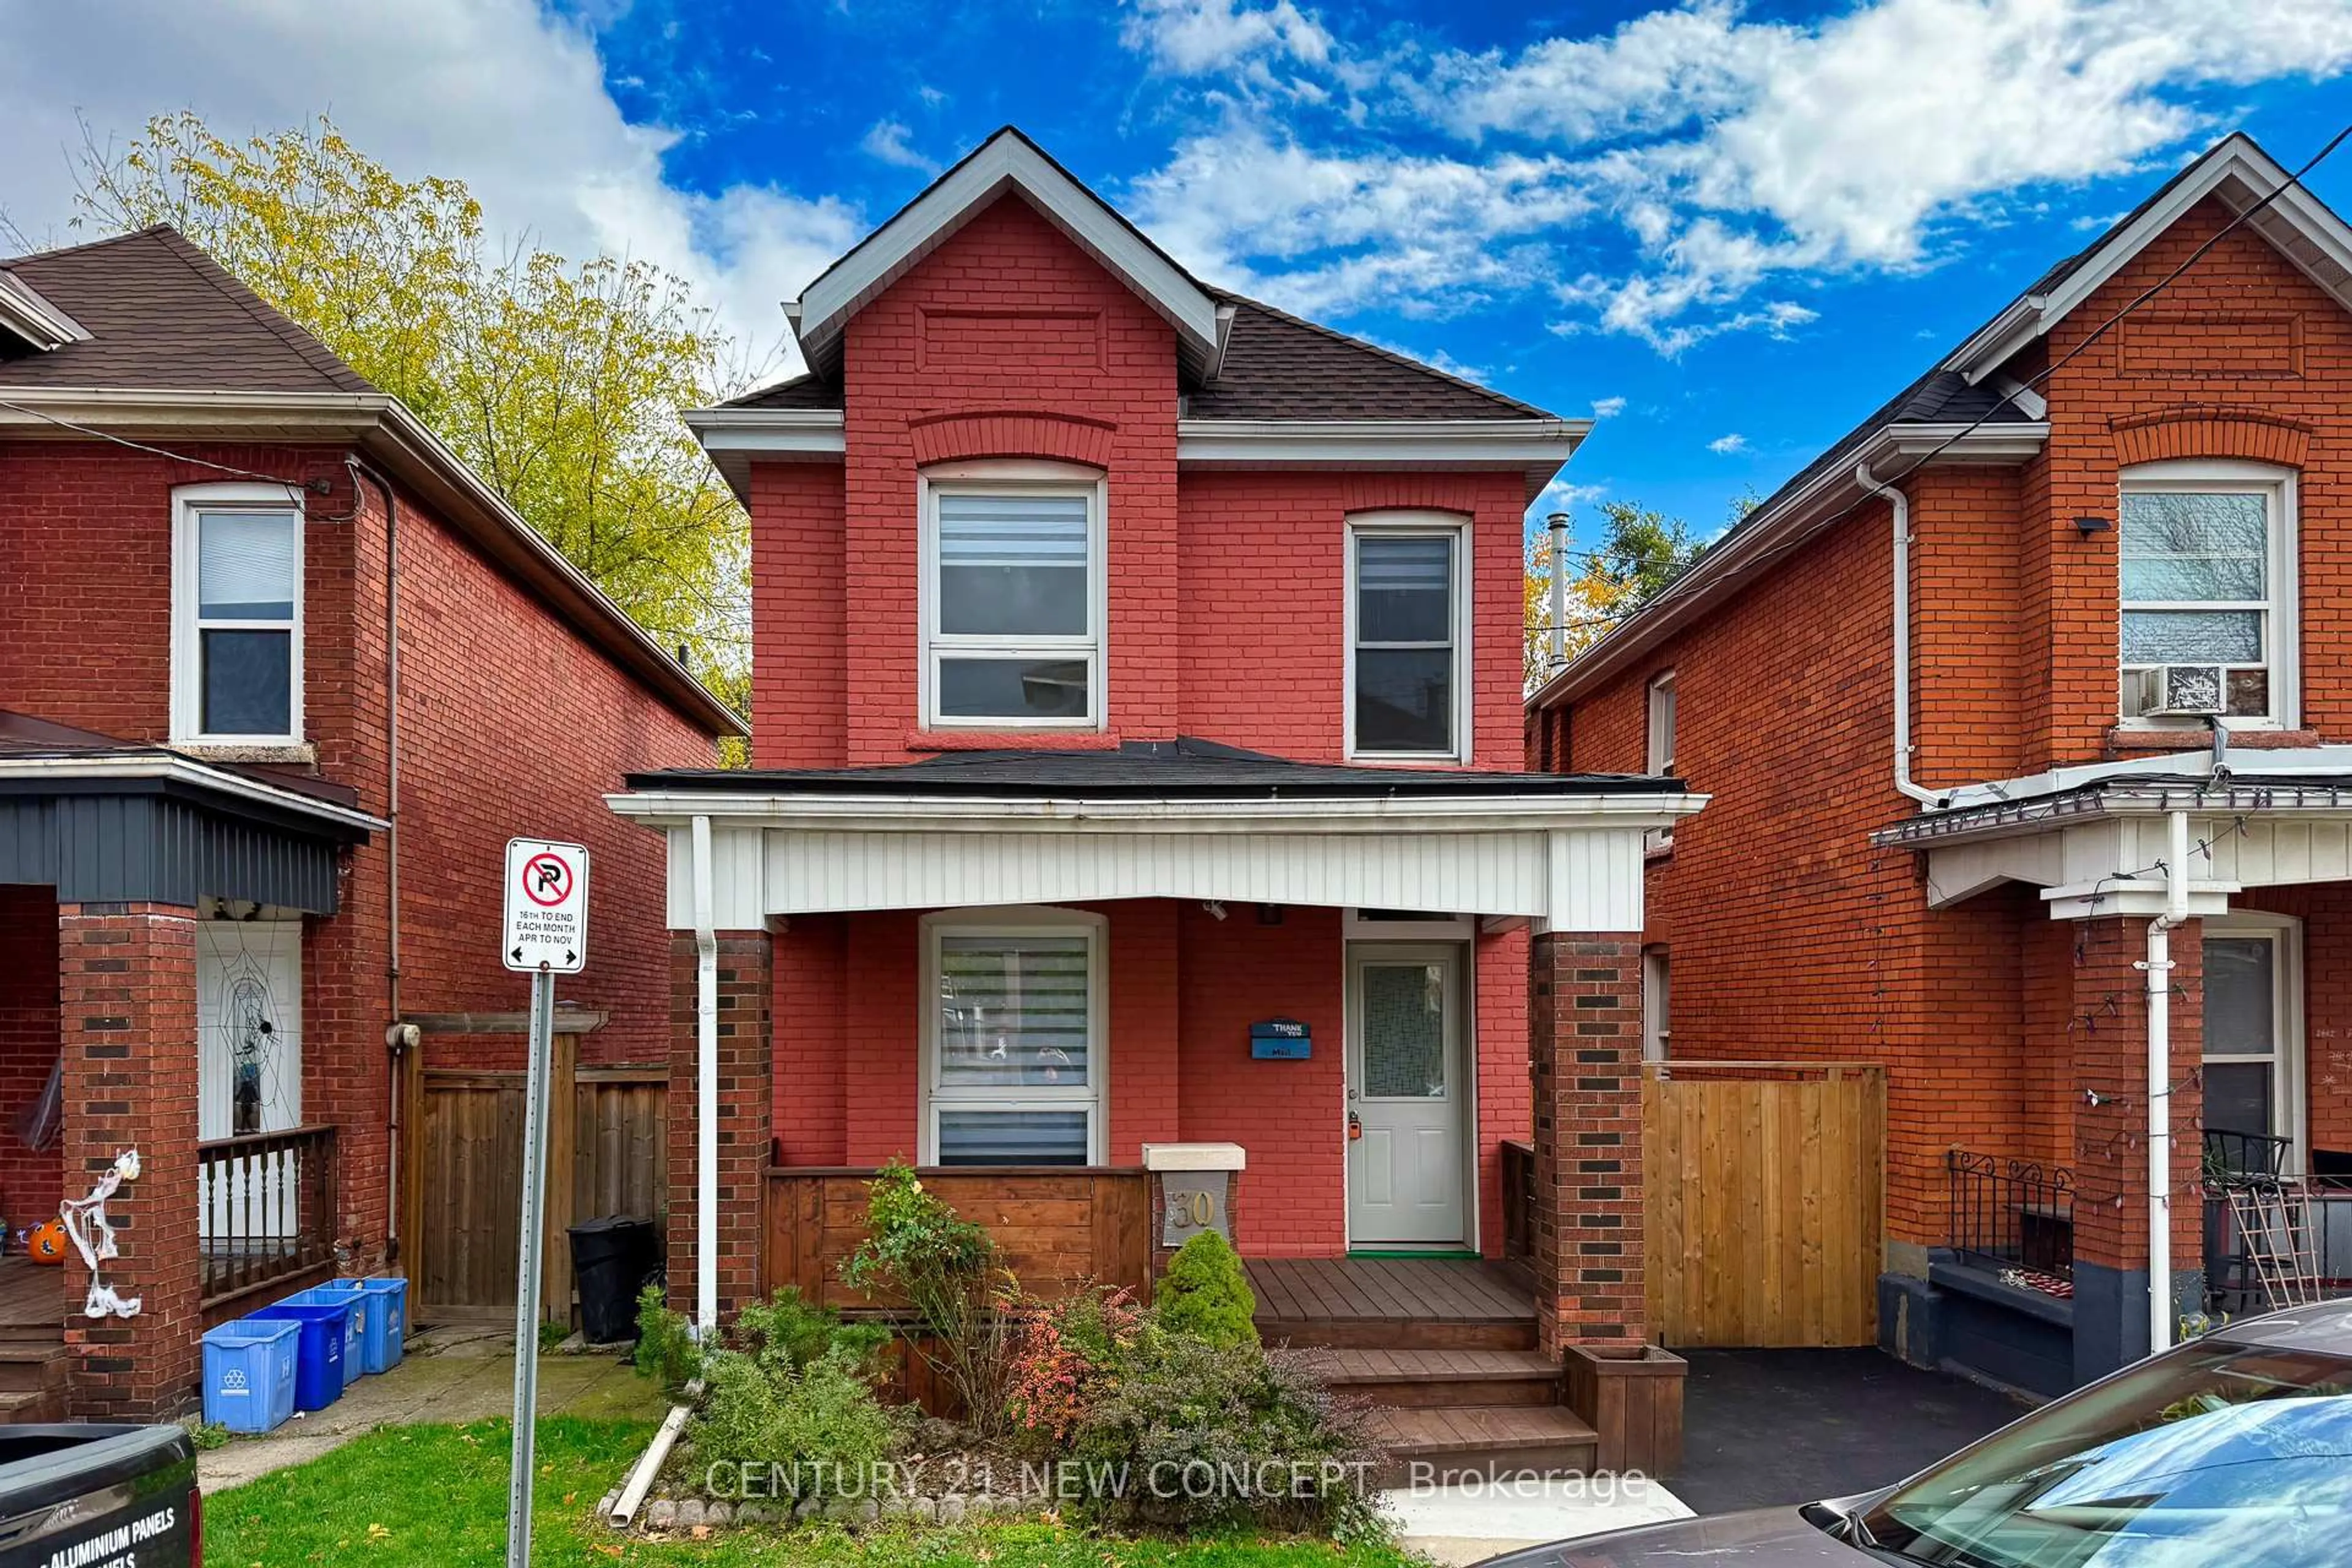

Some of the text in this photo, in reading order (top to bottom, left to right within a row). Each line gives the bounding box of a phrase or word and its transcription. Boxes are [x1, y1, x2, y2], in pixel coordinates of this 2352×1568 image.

[541, 911, 553, 921] TO
[555, 913, 573, 922] END
[516, 921, 575, 933] EACH MONTH
[518, 933, 537, 942] APR
[540, 935, 551, 943] TO
[1172, 1191, 1215, 1227] 30
[51, 1526, 130, 1568] ALUMINIUM
[132, 1507, 175, 1544] PANELS
